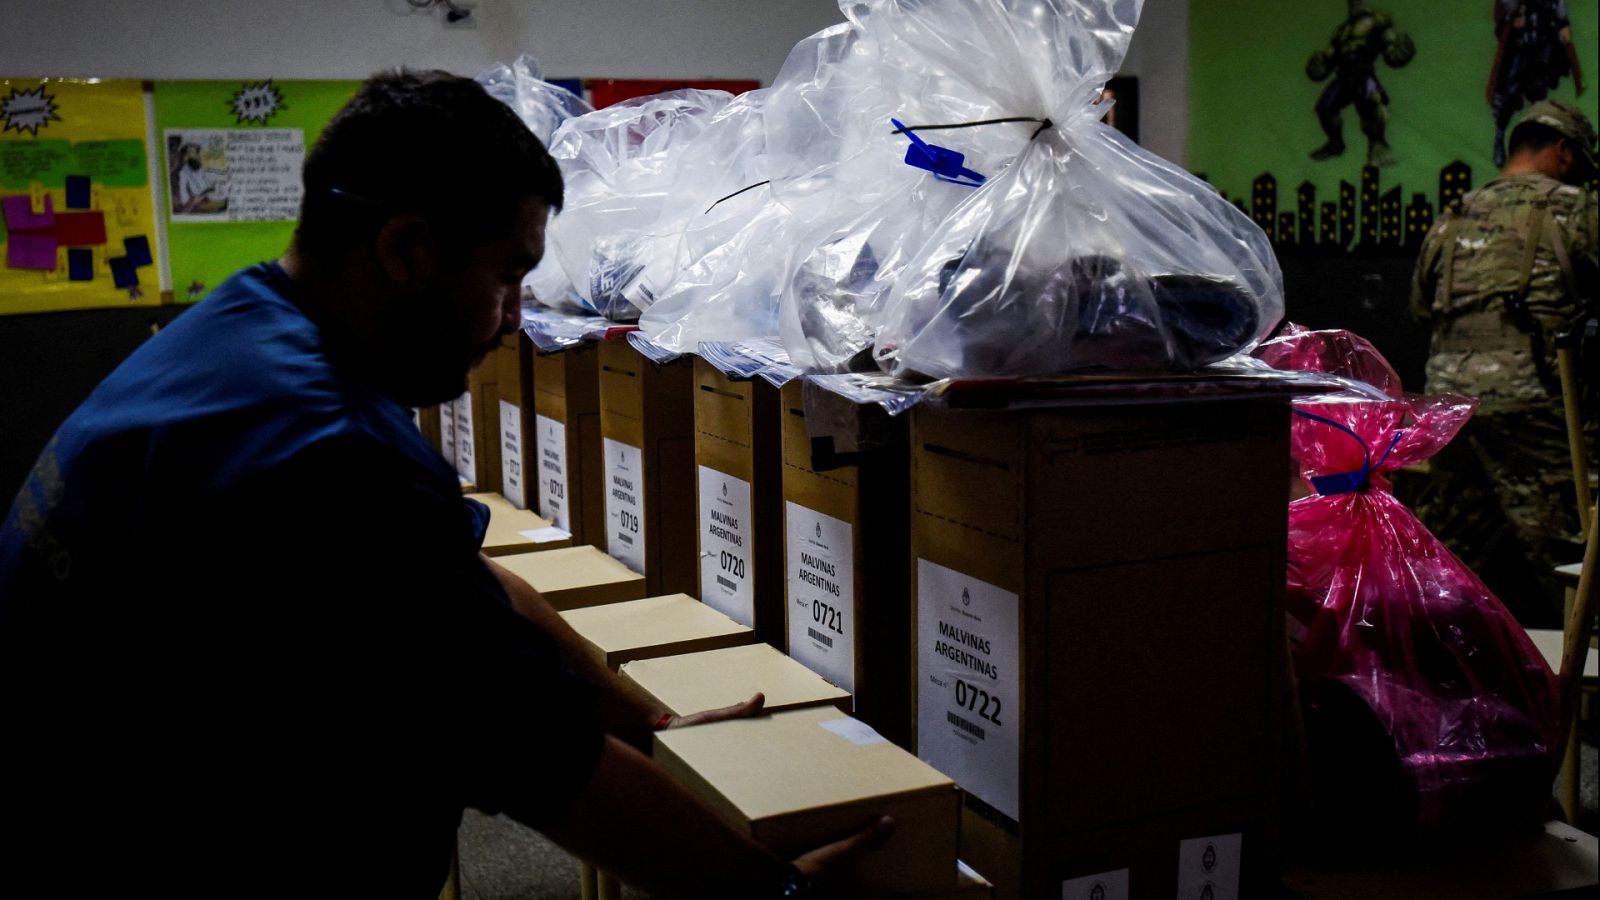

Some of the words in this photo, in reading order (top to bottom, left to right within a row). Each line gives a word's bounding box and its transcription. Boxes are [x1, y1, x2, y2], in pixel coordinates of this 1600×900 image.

[613, 475, 634, 491] MALVINAS
[612, 488, 637, 506] ARGENTINAS
[620, 509, 639, 534] 0719
[711, 509, 738, 530] MALVINAS
[709, 523, 742, 547] ARGENTINAS
[720, 550, 745, 579] 0720
[801, 552, 836, 577] MALVINAS
[798, 568, 840, 598] ARGENTINAS
[813, 599, 844, 635] 0721
[939, 620, 991, 655] MALVINAS
[935, 640, 998, 680] ARGENTINAS
[955, 679, 1002, 727] 0722
